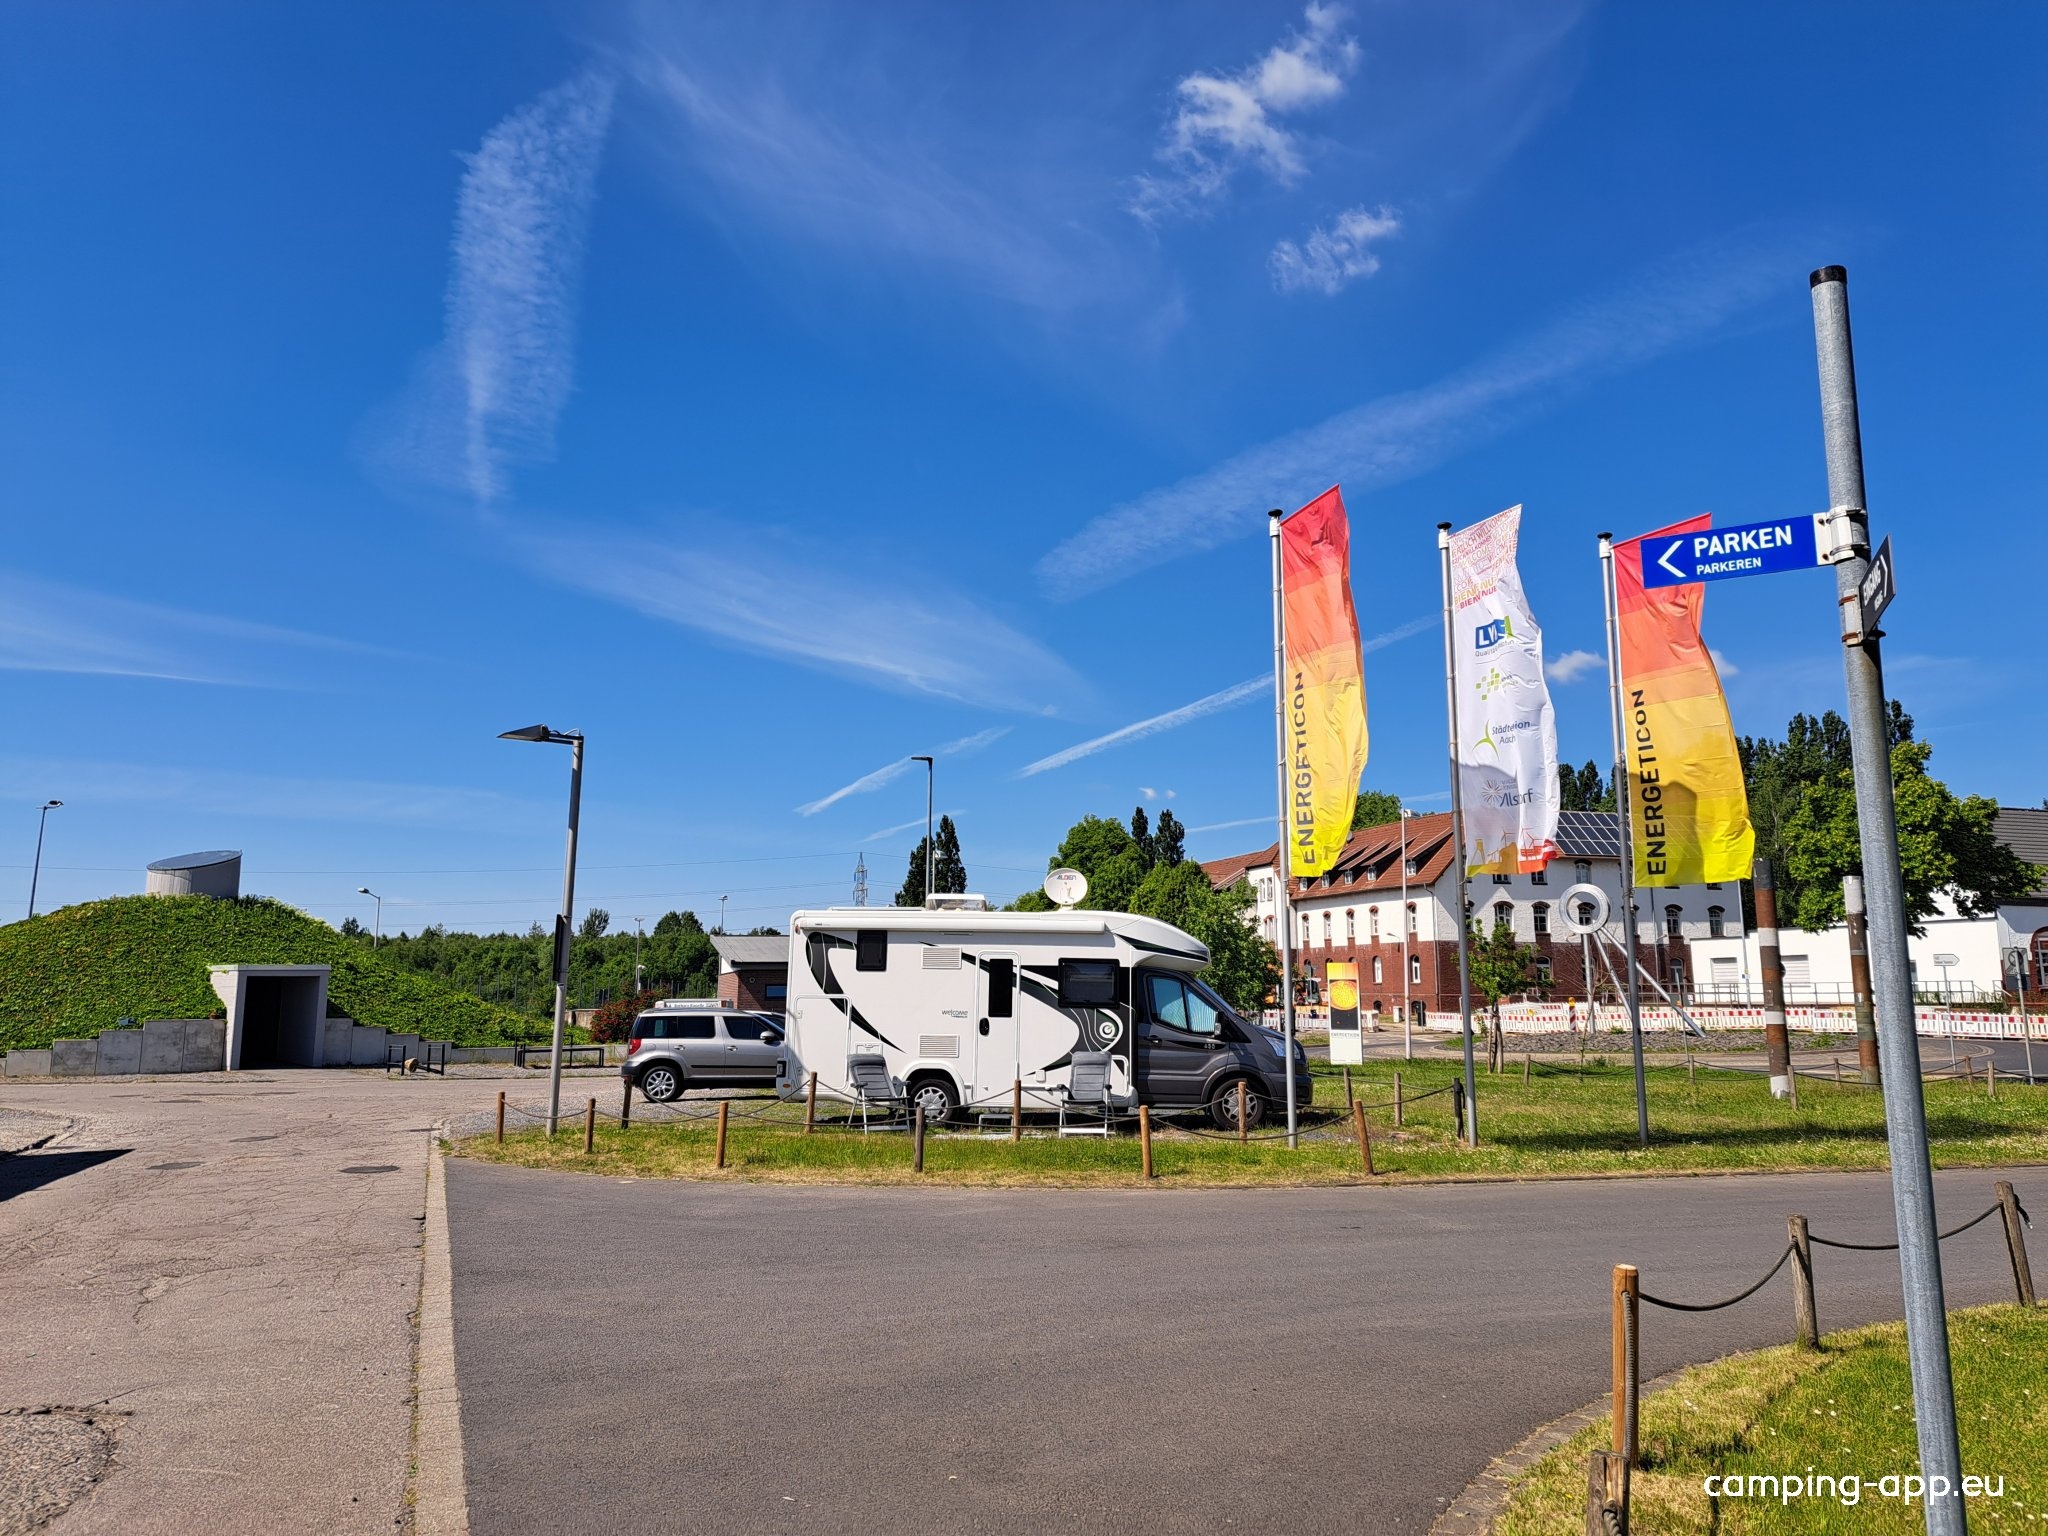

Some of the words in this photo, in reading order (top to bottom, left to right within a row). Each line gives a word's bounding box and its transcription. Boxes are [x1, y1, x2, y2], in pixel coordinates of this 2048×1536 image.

[1693, 525, 1793, 558] PARKEN
[1696, 557, 1762, 576] PARKEREN
[1294, 672, 1316, 865] ENERGETICON
[1631, 689, 1667, 876] ENERGETICON
[941, 1009, 969, 1017] welcome
